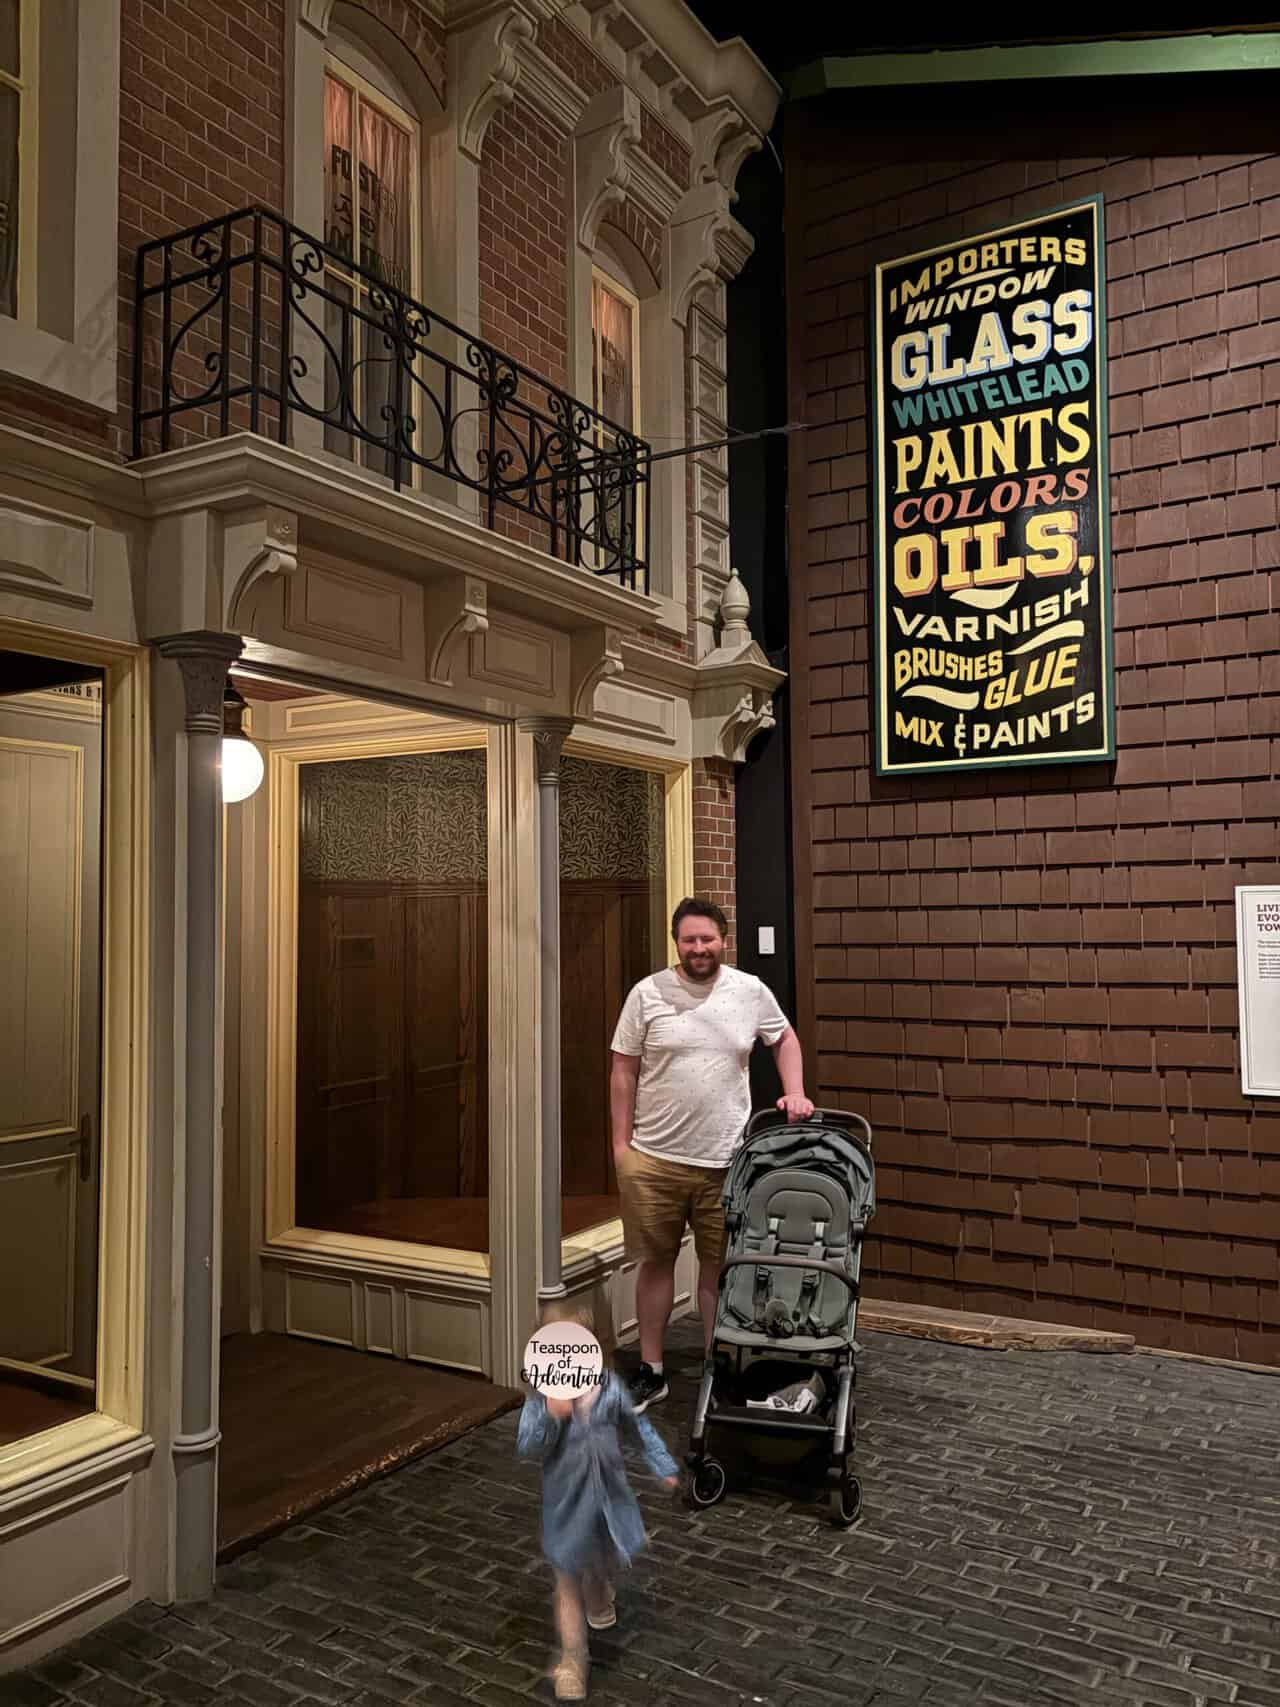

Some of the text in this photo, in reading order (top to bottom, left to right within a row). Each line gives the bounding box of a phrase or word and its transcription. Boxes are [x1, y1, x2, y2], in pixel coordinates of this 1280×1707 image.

[890, 236, 1086, 313] IMPORTERS
[904, 265, 1056, 325] WINDOW
[891, 289, 1092, 392] GLASS
[892, 359, 1090, 429] WHITELEAD
[892, 400, 1090, 495] PAINTS
[893, 468, 1090, 529] COLORS
[894, 510, 1095, 598] OILS,
[892, 577, 1089, 642] VARNISH
[894, 647, 1003, 691] BRUSHES
[984, 644, 1081, 711] GLUE
[895, 712, 944, 747] MIX
[973, 691, 1095, 750] PAINTS
[1257, 904, 1280, 912] LIVI
[1257, 913, 1280, 922] EVO
